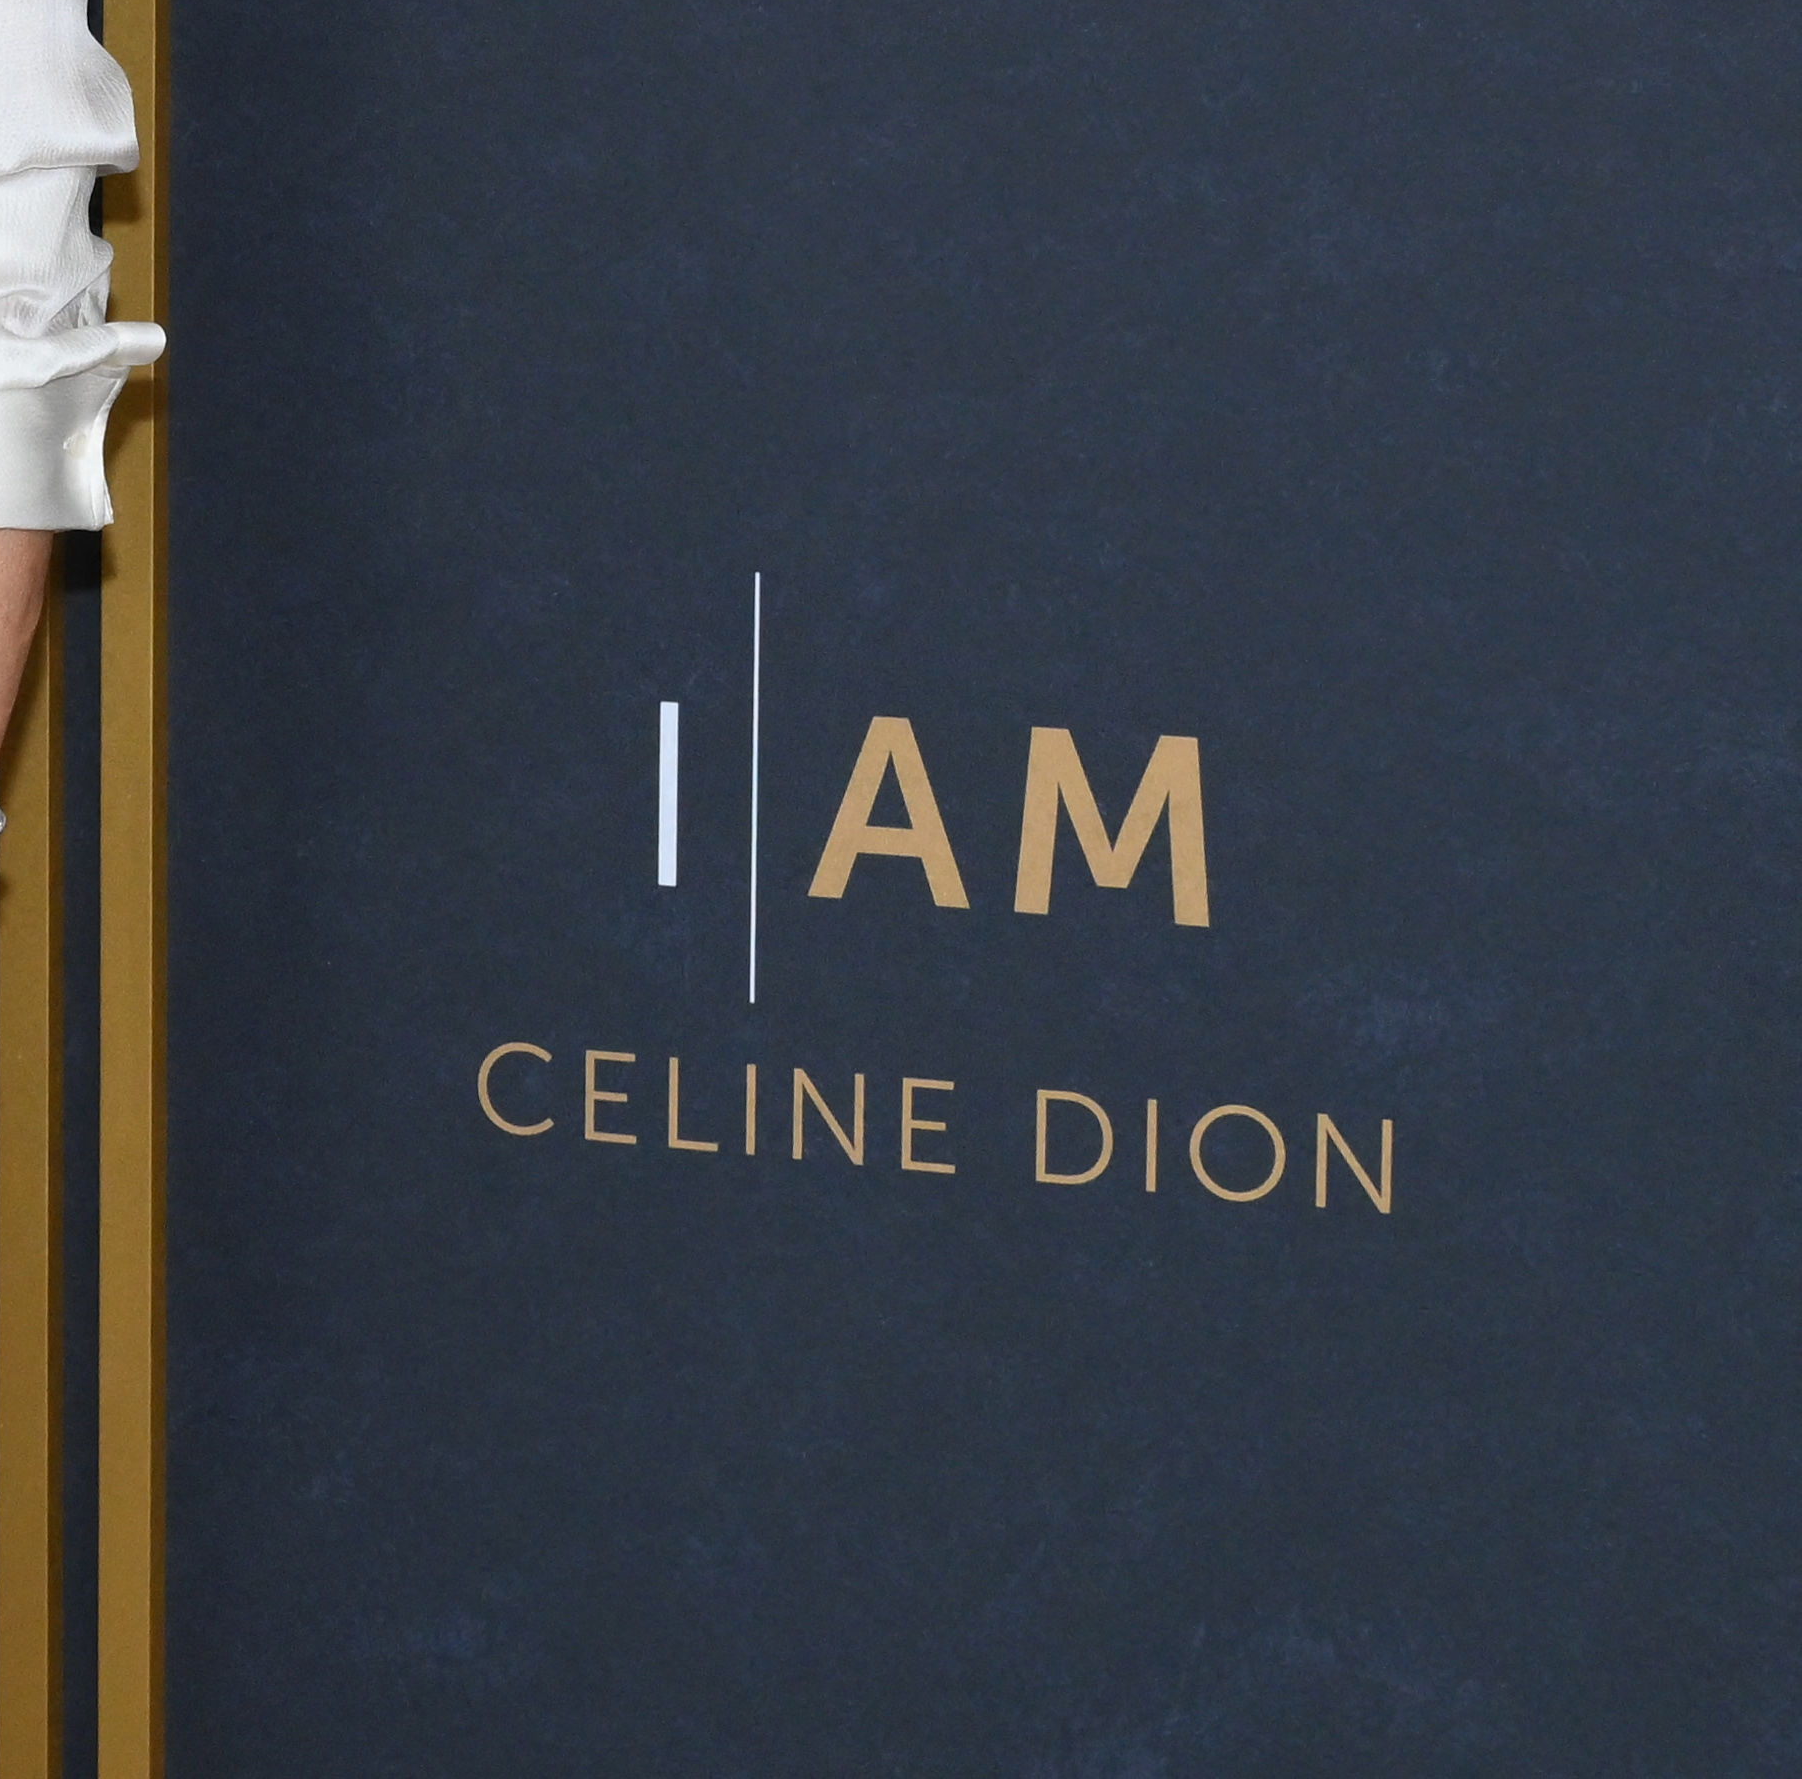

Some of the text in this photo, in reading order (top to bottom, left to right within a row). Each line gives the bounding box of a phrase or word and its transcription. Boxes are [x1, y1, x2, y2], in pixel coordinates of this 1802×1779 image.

[808, 716, 1209, 927] AM
[477, 1042, 1393, 1213] CELINE DION
